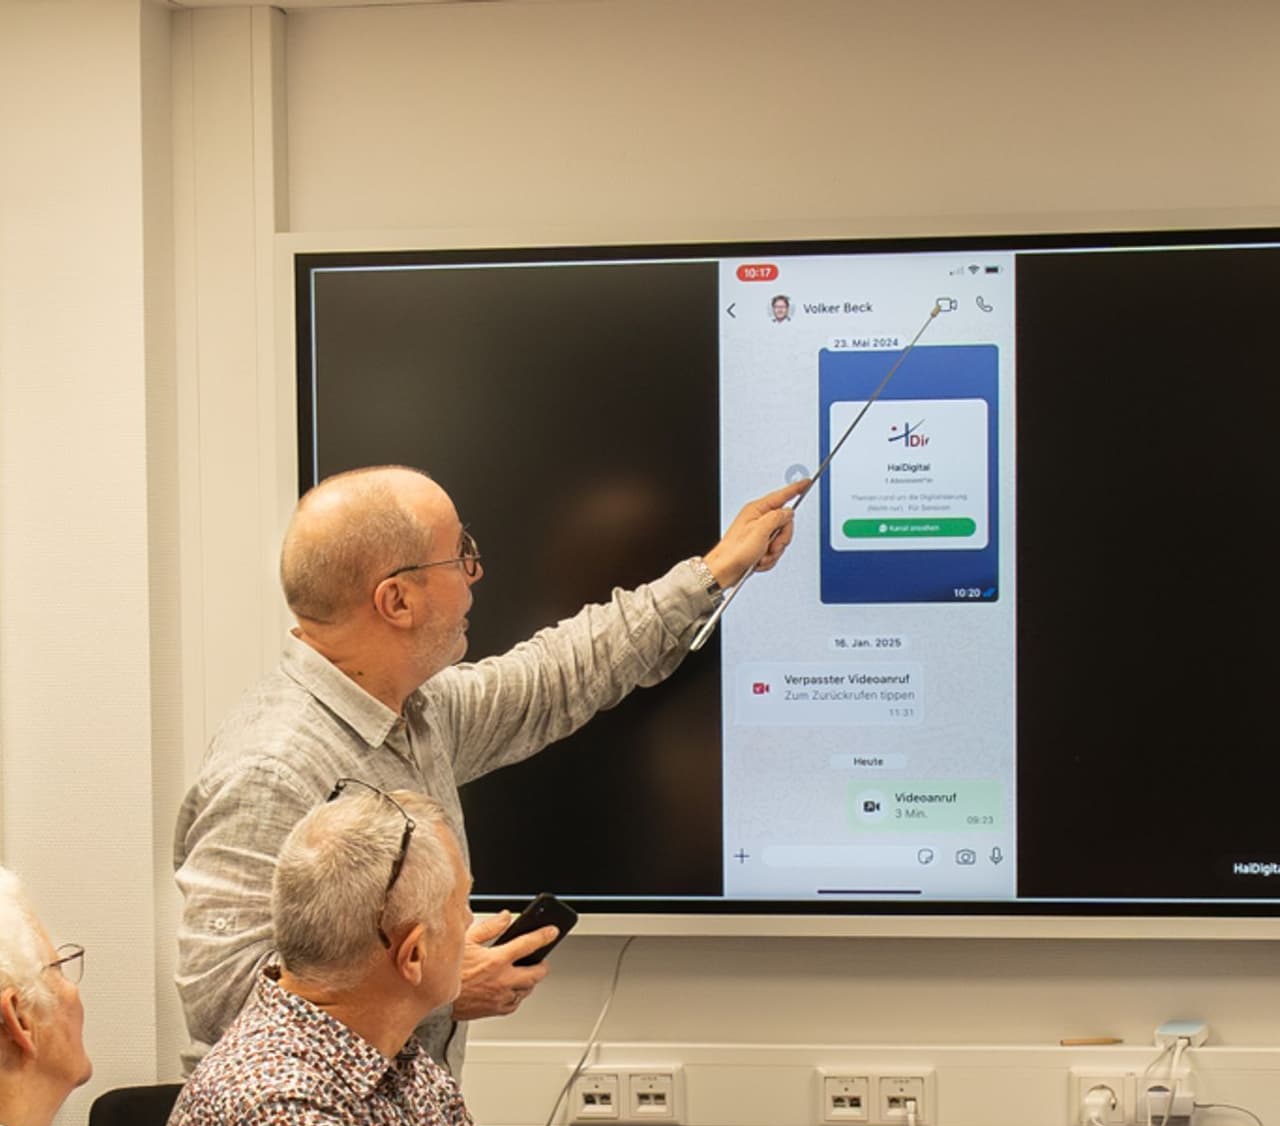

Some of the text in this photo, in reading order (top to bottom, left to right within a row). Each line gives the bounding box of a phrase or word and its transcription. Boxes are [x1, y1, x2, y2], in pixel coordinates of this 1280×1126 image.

[744, 268, 771, 278] 10:17
[803, 302, 873, 314] Volker Beck
[834, 338, 899, 348] 23. Mai 2024
[887, 463, 930, 473] HaiDigital
[954, 588, 981, 598] 10:20
[834, 638, 902, 648] 16. Jan. 2025
[784, 673, 910, 686] Verpasster Videoanruf
[784, 689, 915, 702] Zum Zurückrufen tippen
[889, 708, 914, 717] 11:31
[854, 757, 884, 766] Heute
[895, 793, 957, 804] Videoanruf
[895, 809, 928, 818] 3 Min.
